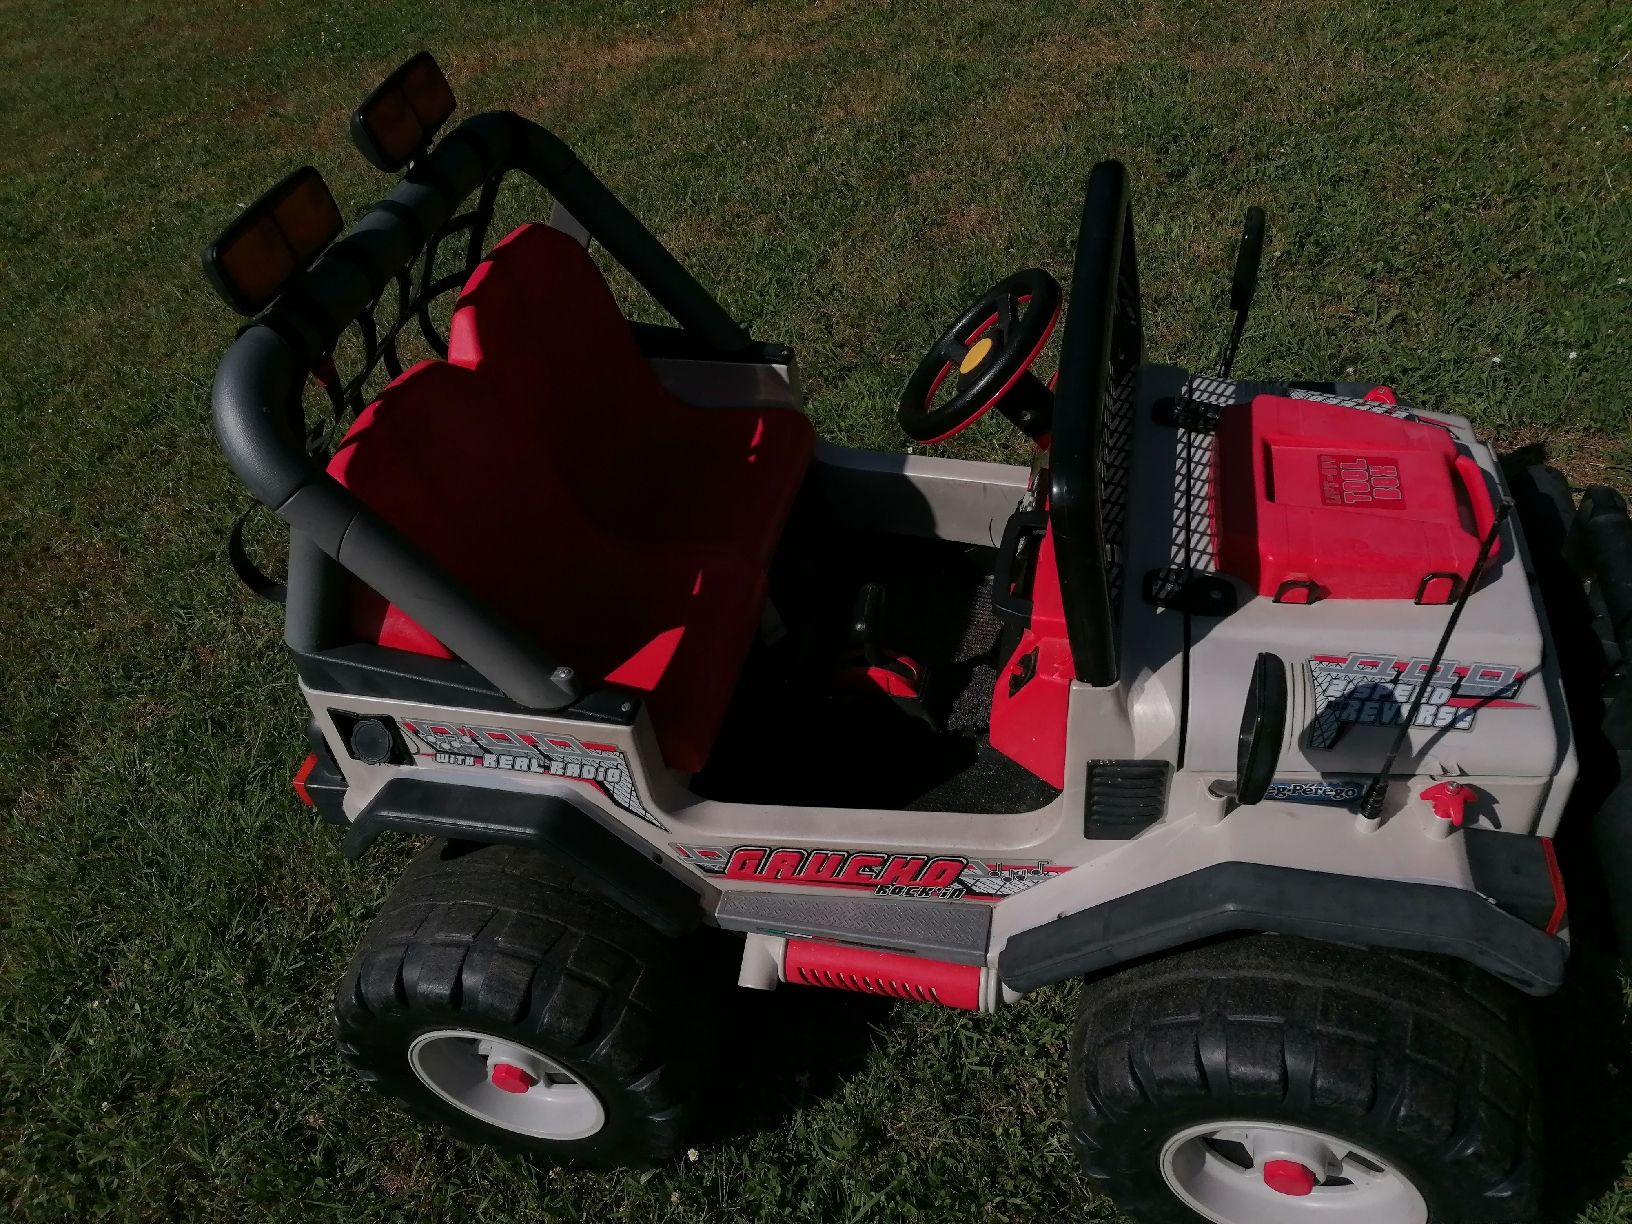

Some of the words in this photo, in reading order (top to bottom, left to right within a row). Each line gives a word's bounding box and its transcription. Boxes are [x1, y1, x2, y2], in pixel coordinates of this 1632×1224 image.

[1340, 458, 1372, 504] TOOL
[1368, 465, 1402, 500] BOX
[483, 753, 545, 774] REAL
[725, 845, 970, 888] GAUCHO
